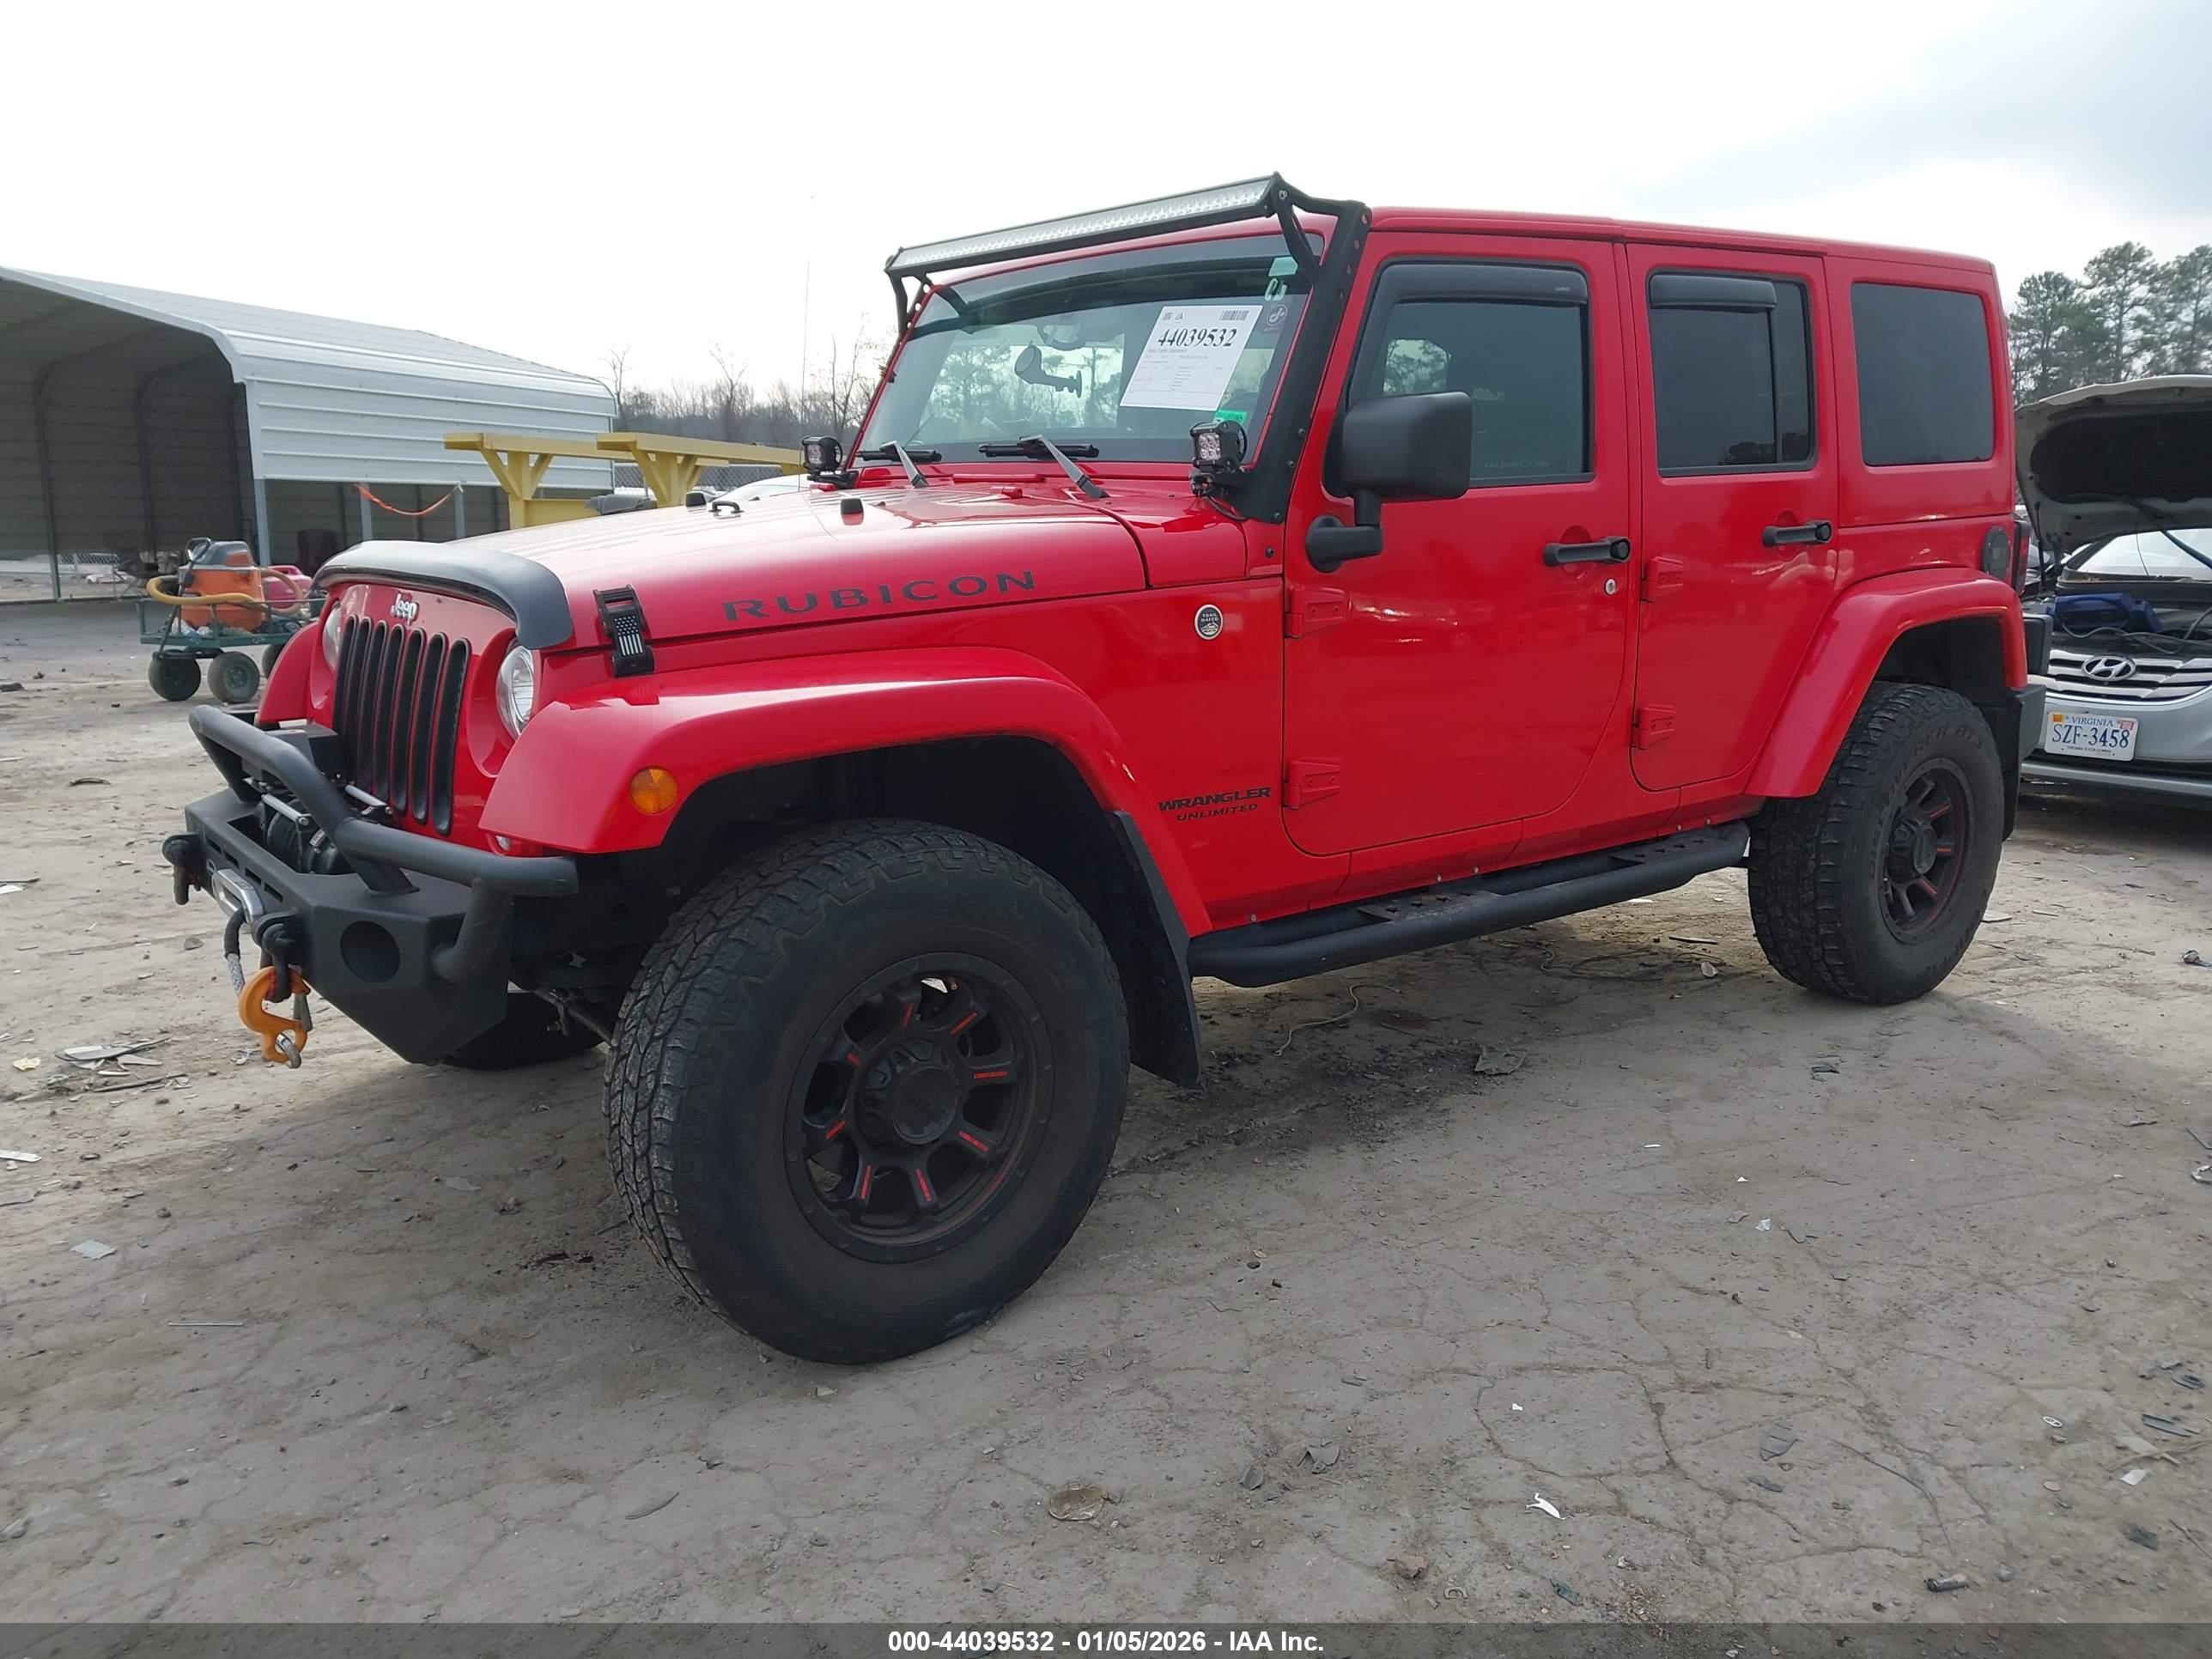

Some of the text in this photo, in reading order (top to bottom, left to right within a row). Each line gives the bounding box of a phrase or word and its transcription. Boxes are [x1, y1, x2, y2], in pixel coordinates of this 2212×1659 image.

[1158, 328, 1237, 347] 44039532
[722, 569, 1035, 622] RUBICON
[391, 593, 417, 626] Jeep
[2072, 716, 2113, 726] VIRGINIA
[2051, 724, 2130, 748] SZF-3458
[1158, 787, 1272, 811] WRANGLER
[1176, 803, 1258, 821] UNLIMITED
